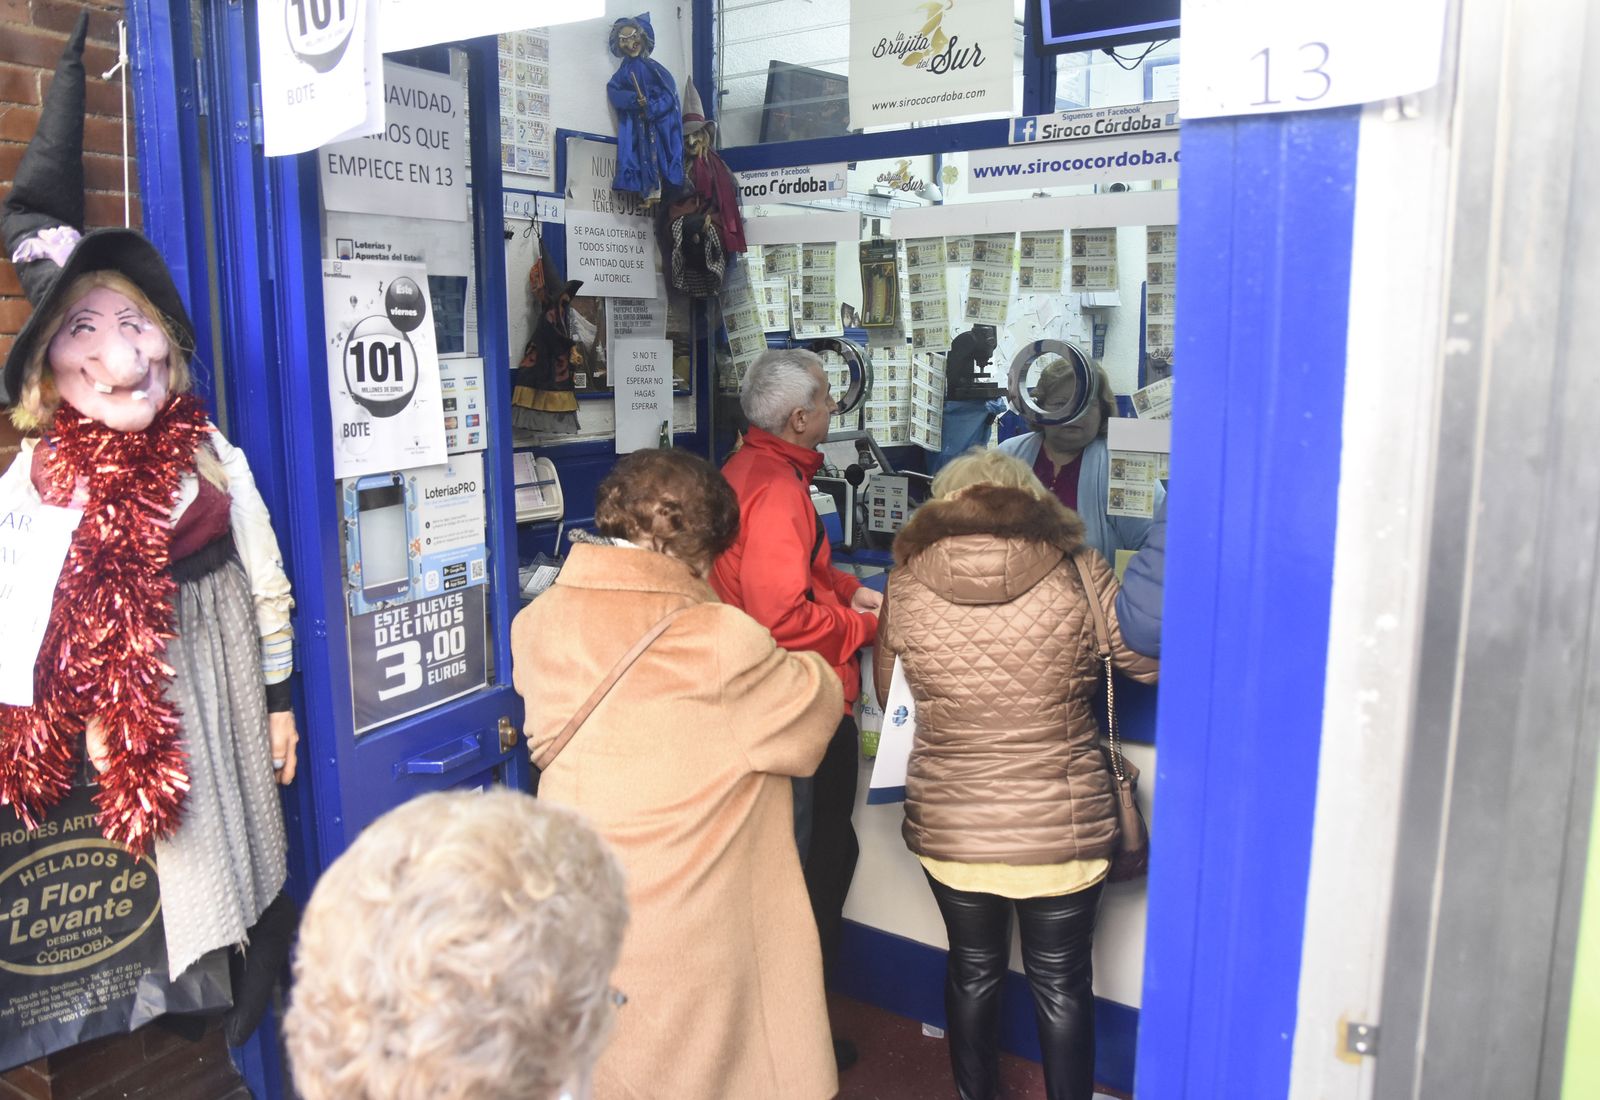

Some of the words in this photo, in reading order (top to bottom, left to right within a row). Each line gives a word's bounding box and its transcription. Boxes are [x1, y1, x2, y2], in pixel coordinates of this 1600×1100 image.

[896, 31, 905, 41] la
[872, 33, 930, 59] Brujita
[916, 59, 929, 70] del
[926, 36, 986, 75] Sur
[1250, 41, 1331, 106] 13
[287, 83, 316, 105] BOTE
[872, 89, 986, 111] www.sirococordoba.com
[1107, 106, 1142, 115] Facebook
[1042, 123, 1091, 140] Siroco
[1094, 114, 1161, 135] Córdoba
[416, 127, 451, 150] QUE
[328, 153, 404, 182] EMPIECE
[409, 163, 430, 185] EN
[436, 166, 454, 187] 13
[592, 156, 617, 178] NUN
[781, 166, 811, 177] Facebook
[739, 184, 767, 197] roco
[770, 176, 827, 195] Córdoba
[900, 175, 924, 192] Sur
[593, 188, 606, 201] VAS
[592, 200, 614, 214] TENER
[574, 226, 583, 236] SE
[585, 226, 605, 237] PAGA
[637, 230, 647, 240] DE
[355, 252, 390, 261] Apuestas
[388, 243, 392, 252] y
[578, 242, 604, 252] TODOS
[630, 245, 634, 253] Y
[635, 246, 645, 255] LA
[580, 257, 617, 268] CANTIDAD
[619, 259, 635, 269] QUE
[636, 260, 645, 269] SE
[594, 273, 633, 283] AUTORICE.
[396, 285, 413, 295] Este
[390, 307, 417, 317] viernes
[350, 341, 404, 383] 101
[632, 351, 638, 359] SI
[640, 351, 649, 359] NO
[635, 364, 655, 372] GUSTA
[626, 377, 652, 385] ESPERAR
[654, 377, 663, 385] NO
[634, 390, 655, 398] HAGAS
[343, 422, 370, 438] BOTE
[425, 481, 476, 500] LoteríasPRO
[374, 606, 409, 629] ESTE
[414, 592, 463, 618] JUEVES
[427, 660, 466, 685] EUROS
[62, 814, 98, 833] ART
[19, 852, 118, 887] HELADOS
[40, 880, 102, 911] Flor
[110, 869, 147, 894] de
[10, 898, 133, 945] Levante
[46, 932, 79, 947] DESDE
[81, 926, 102, 939] 1934
[36, 935, 113, 965] CÓRDOBA
[59, 1011, 79, 1024] 14001
